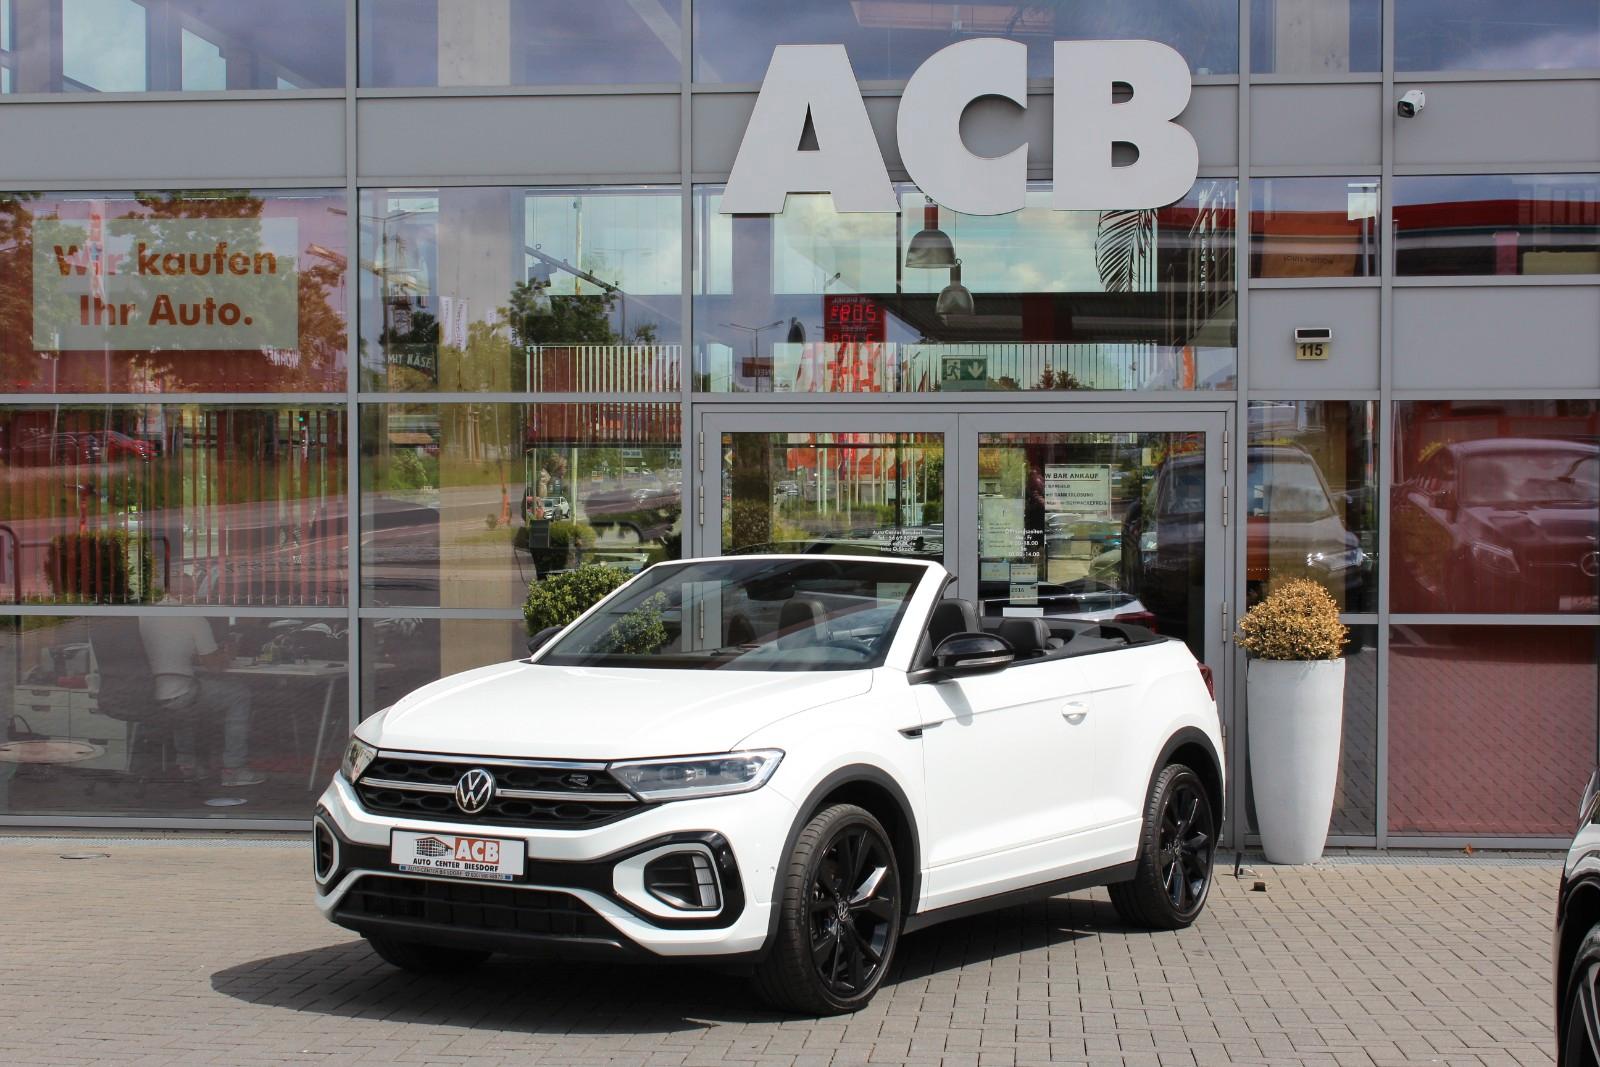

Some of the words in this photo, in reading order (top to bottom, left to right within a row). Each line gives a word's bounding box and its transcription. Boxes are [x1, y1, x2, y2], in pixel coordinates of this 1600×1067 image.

[720, 37, 1199, 216] ACB
[138, 242, 277, 276] kaufen
[80, 295, 136, 326] Ihr
[148, 294, 254, 326] Auto.
[1300, 343, 1323, 357] 115
[456, 840, 499, 862] ACB
[412, 858, 431, 866] AUTO
[435, 860, 460, 869] CENTER
[464, 862, 499, 872] BIESDORF
